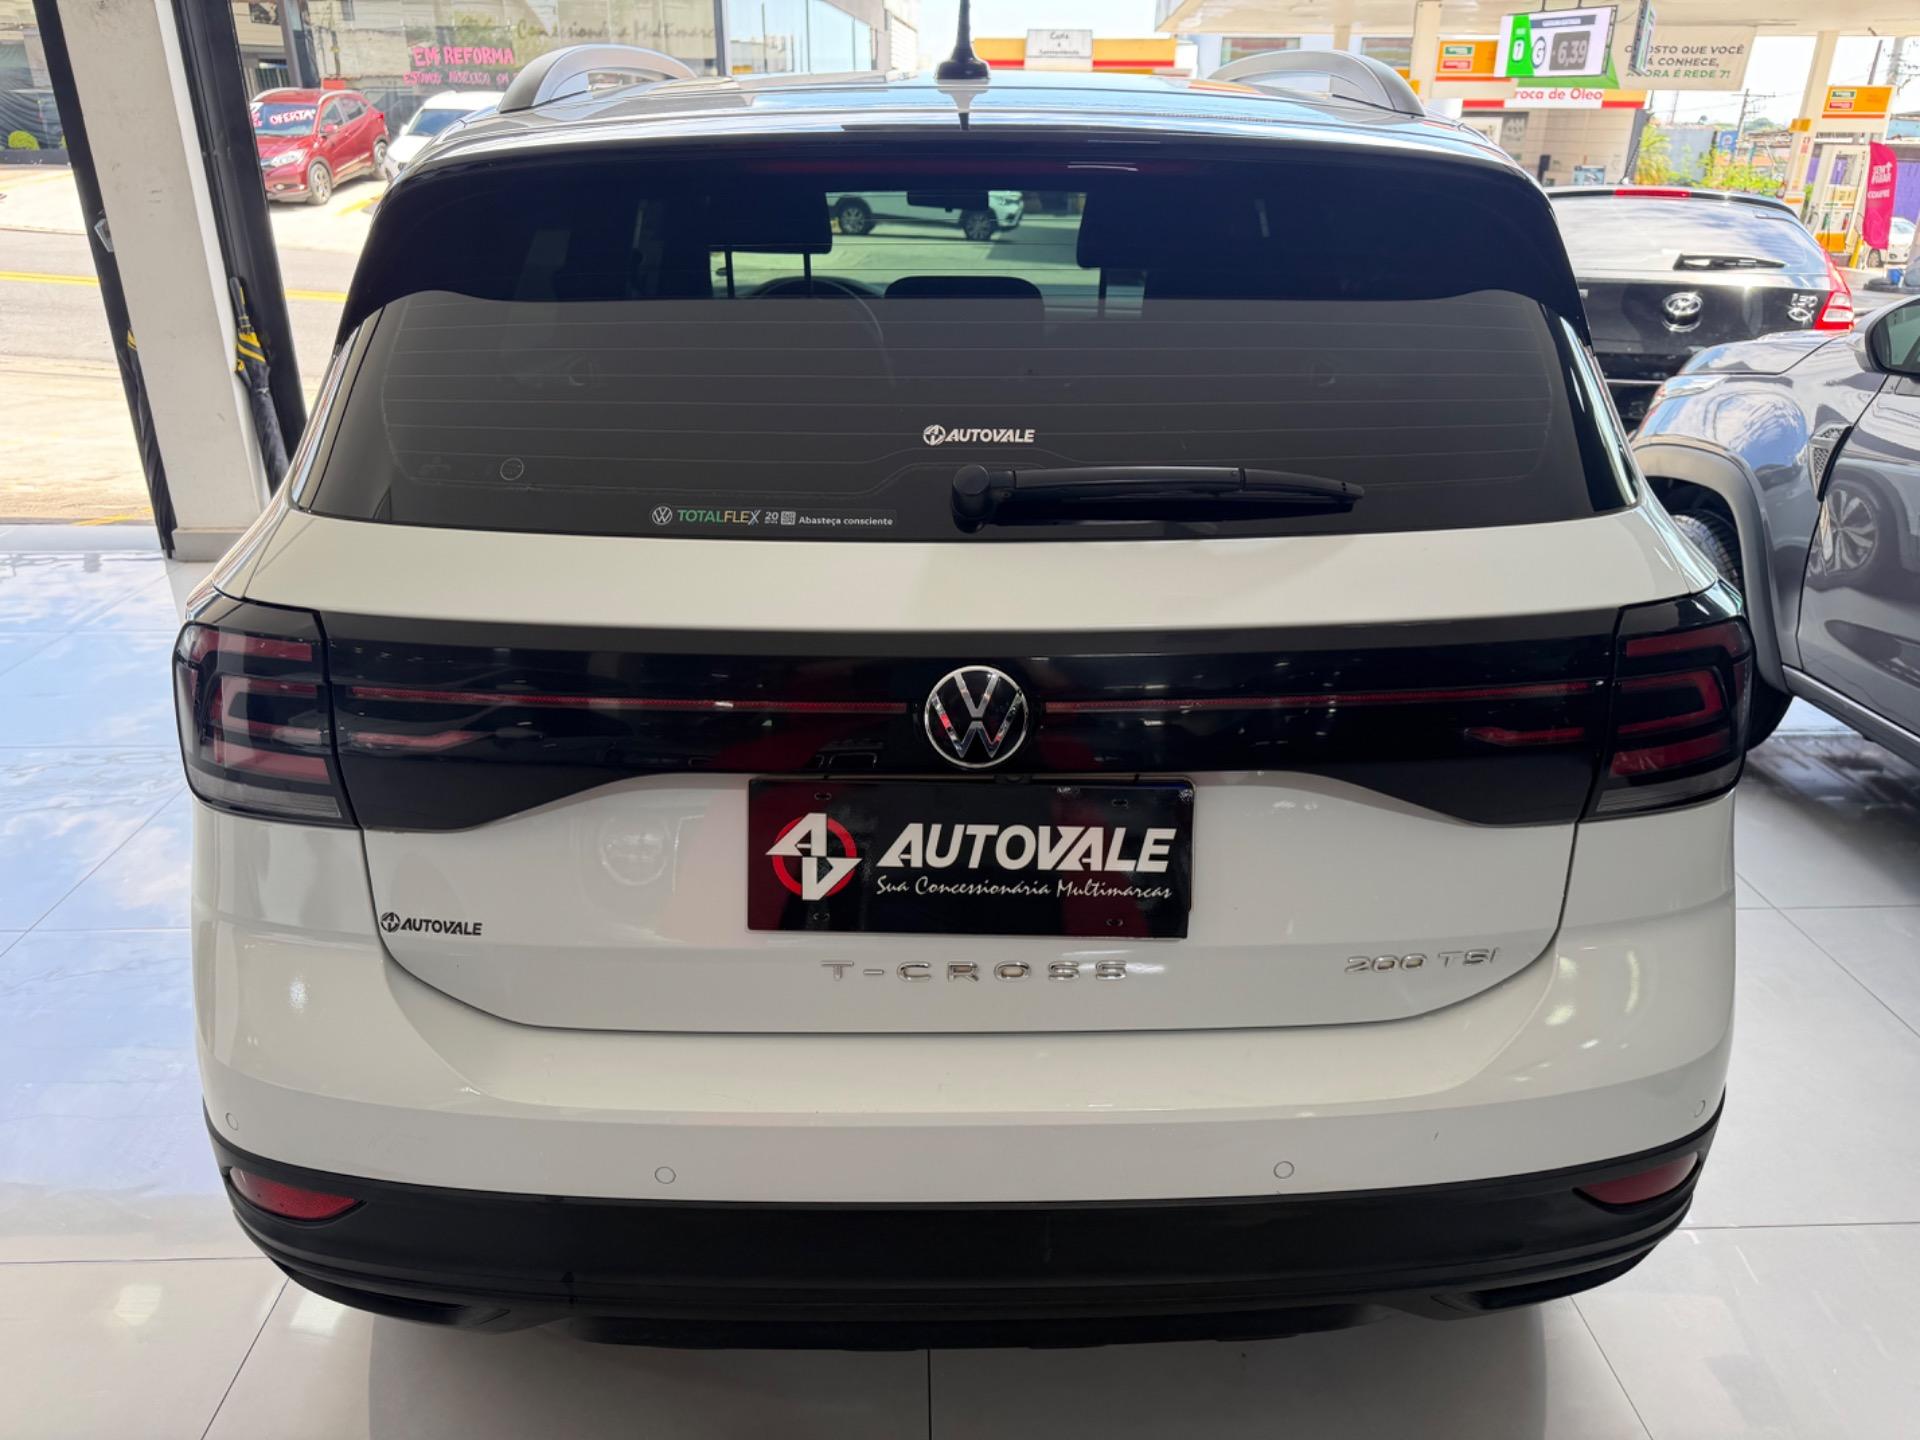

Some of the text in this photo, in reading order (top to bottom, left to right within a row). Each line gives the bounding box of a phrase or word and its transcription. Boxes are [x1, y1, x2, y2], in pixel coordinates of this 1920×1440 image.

[412, 46, 516, 67] EM REFORMA
[1681, 45, 1708, 55] QUE
[1710, 44, 1745, 55] VOCÊ
[1657, 57, 1720, 67] CONHECE,
[1625, 69, 1669, 78] AORA
[1683, 69, 1716, 79] REDE
[1515, 89, 1544, 100] roca
[1548, 88, 1566, 100] de
[945, 429, 1035, 443] AUTOVALE
[677, 509, 761, 525] TOTALFLEX
[798, 516, 841, 526] Abasteça
[843, 516, 893, 526] consciente
[876, 822, 1177, 873] AUTOVALE
[876, 874, 1173, 899] Sua Concessionária Multimarcas
[400, 917, 483, 936] AUTOVALE
[1344, 947, 1499, 974] 200 TSI
[821, 959, 1128, 982] T-CROSS
